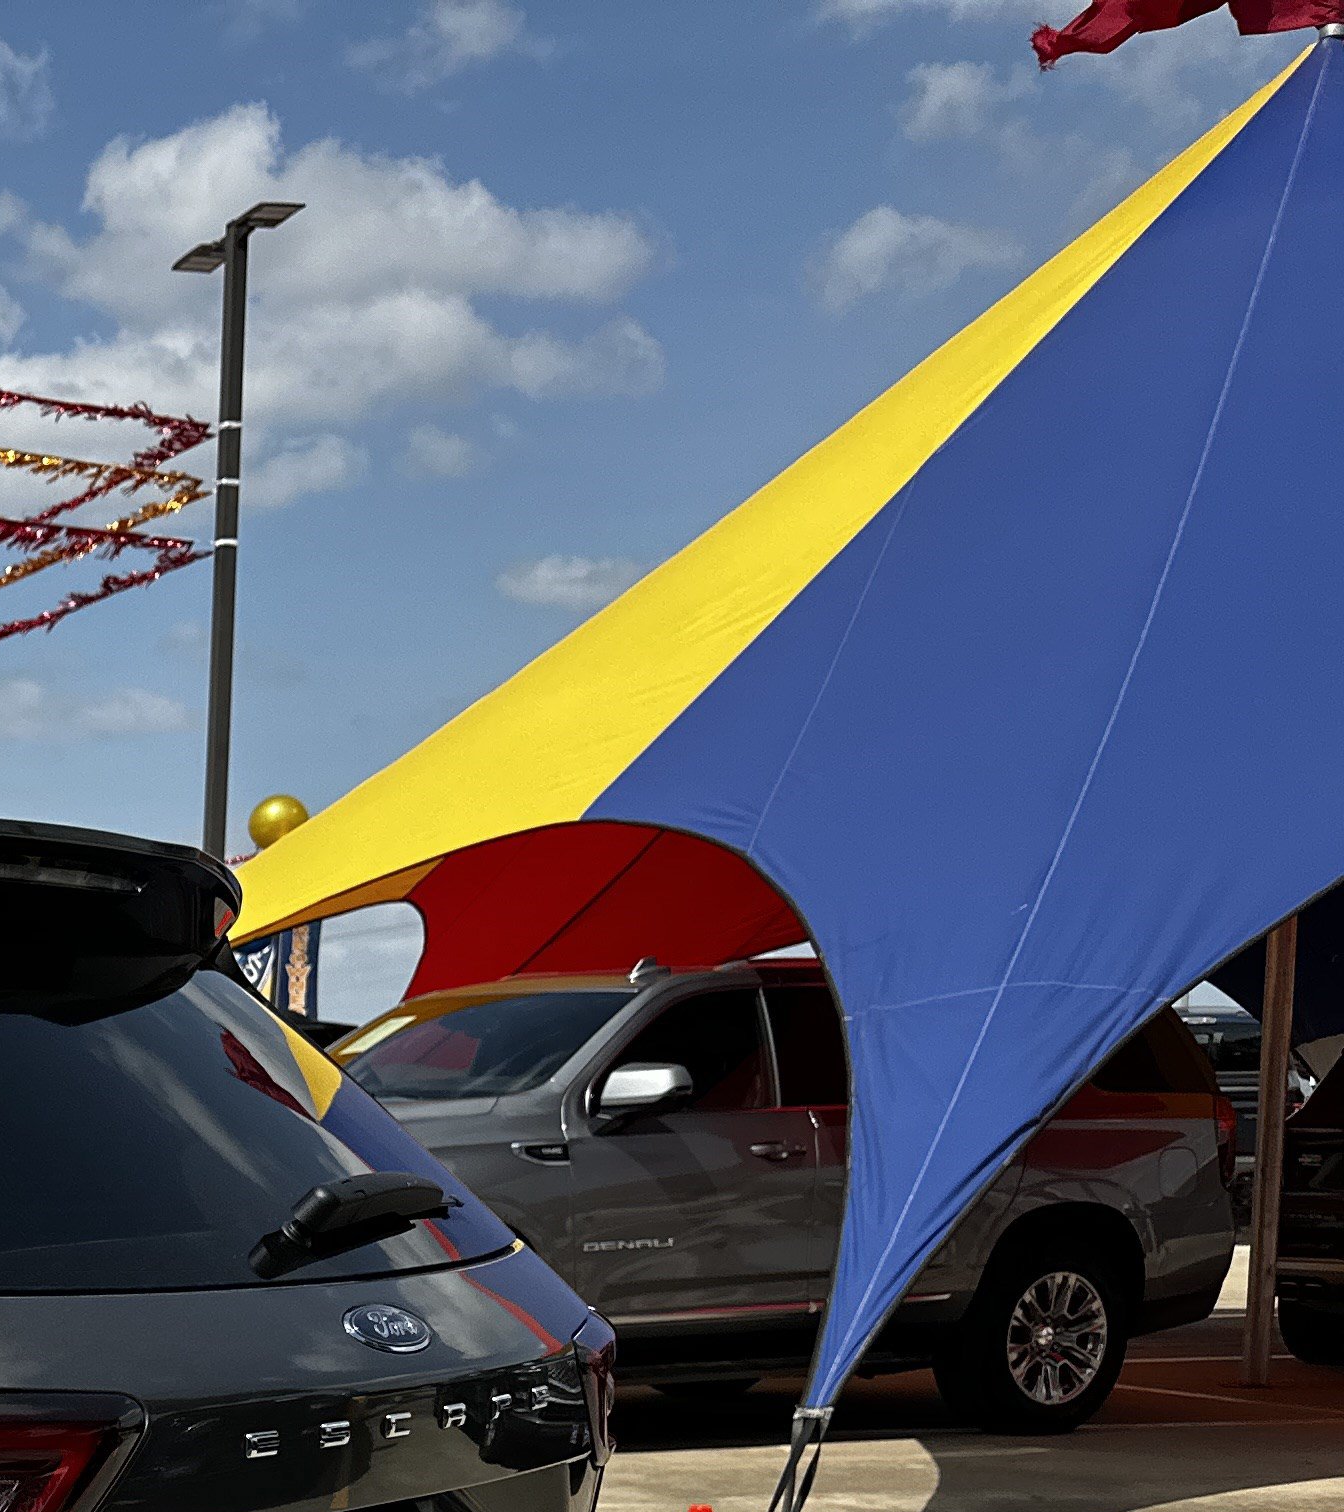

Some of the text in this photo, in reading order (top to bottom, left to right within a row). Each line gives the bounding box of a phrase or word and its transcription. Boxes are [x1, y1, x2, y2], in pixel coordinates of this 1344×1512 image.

[582, 1237, 674, 1253] DENALI
[366, 1311, 419, 1338] Ford
[244, 1384, 550, 1460] ESCAPE
